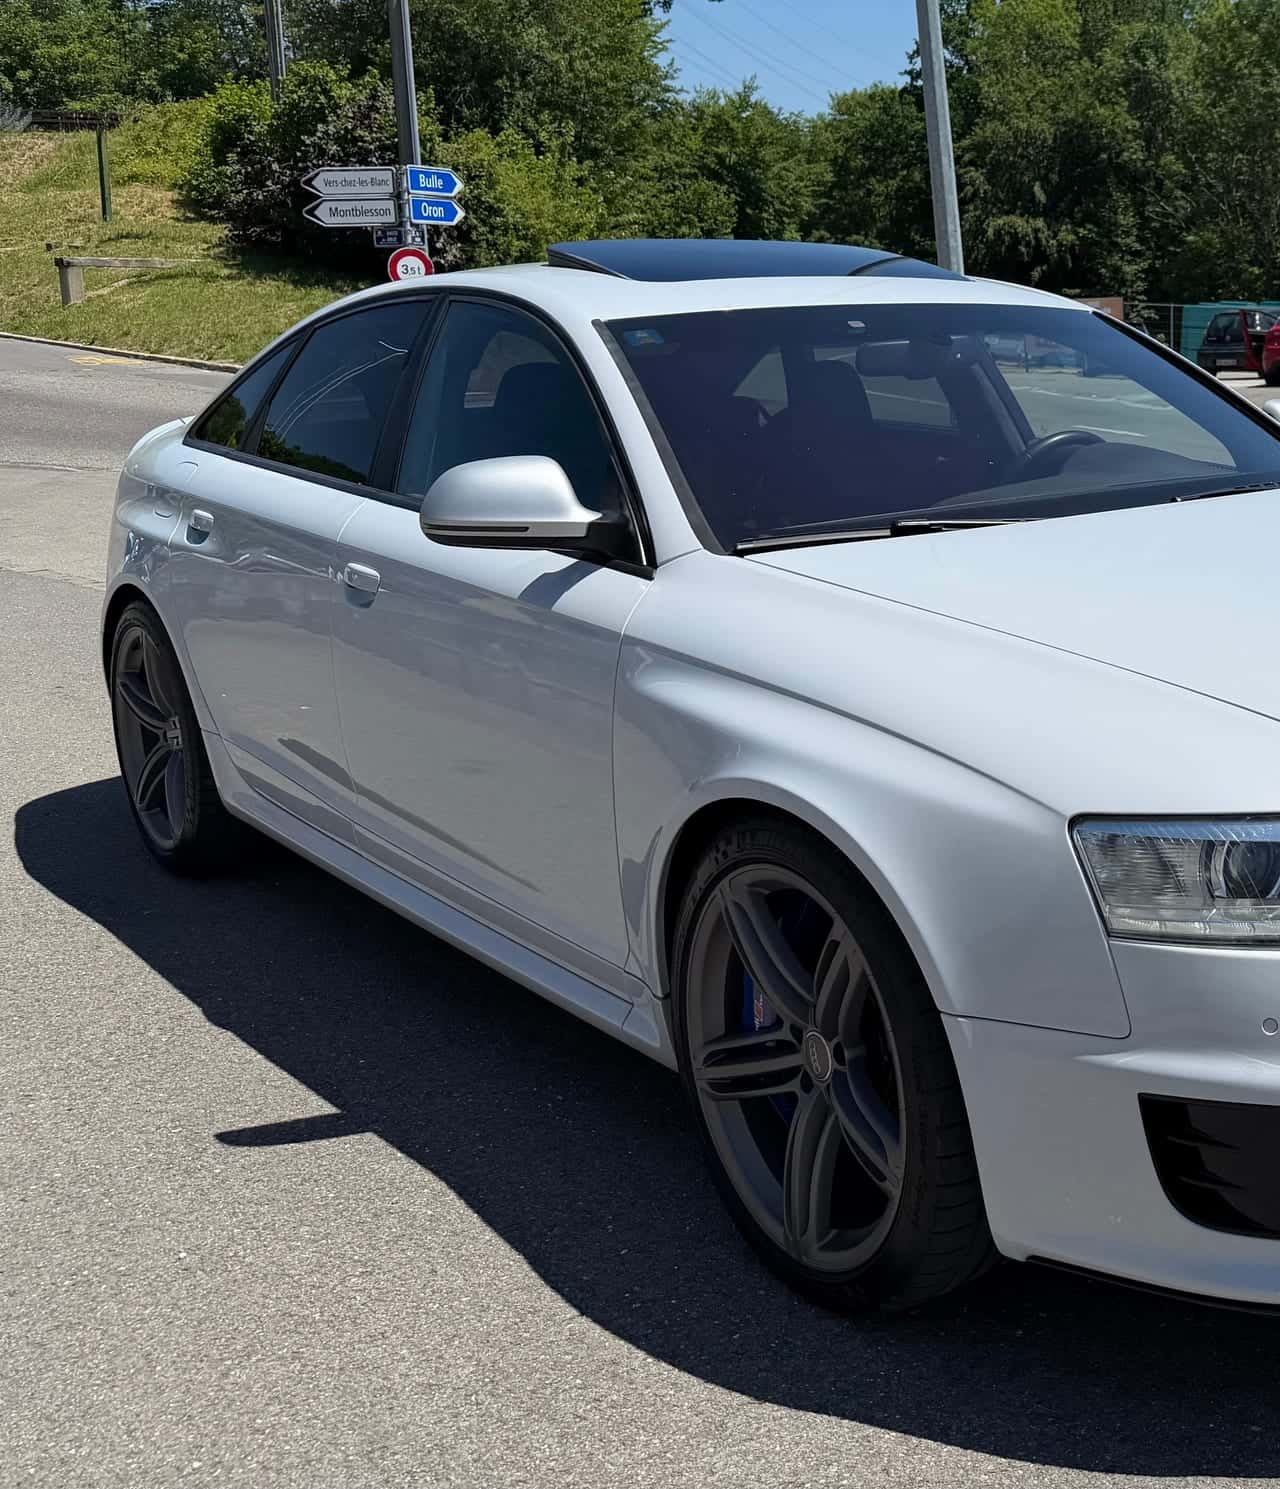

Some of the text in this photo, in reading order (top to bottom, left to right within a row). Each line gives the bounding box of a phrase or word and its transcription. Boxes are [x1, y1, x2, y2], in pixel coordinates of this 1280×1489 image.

[419, 174, 443, 189] Bulle
[329, 205, 391, 217] Montblesson
[421, 202, 444, 217] Oron
